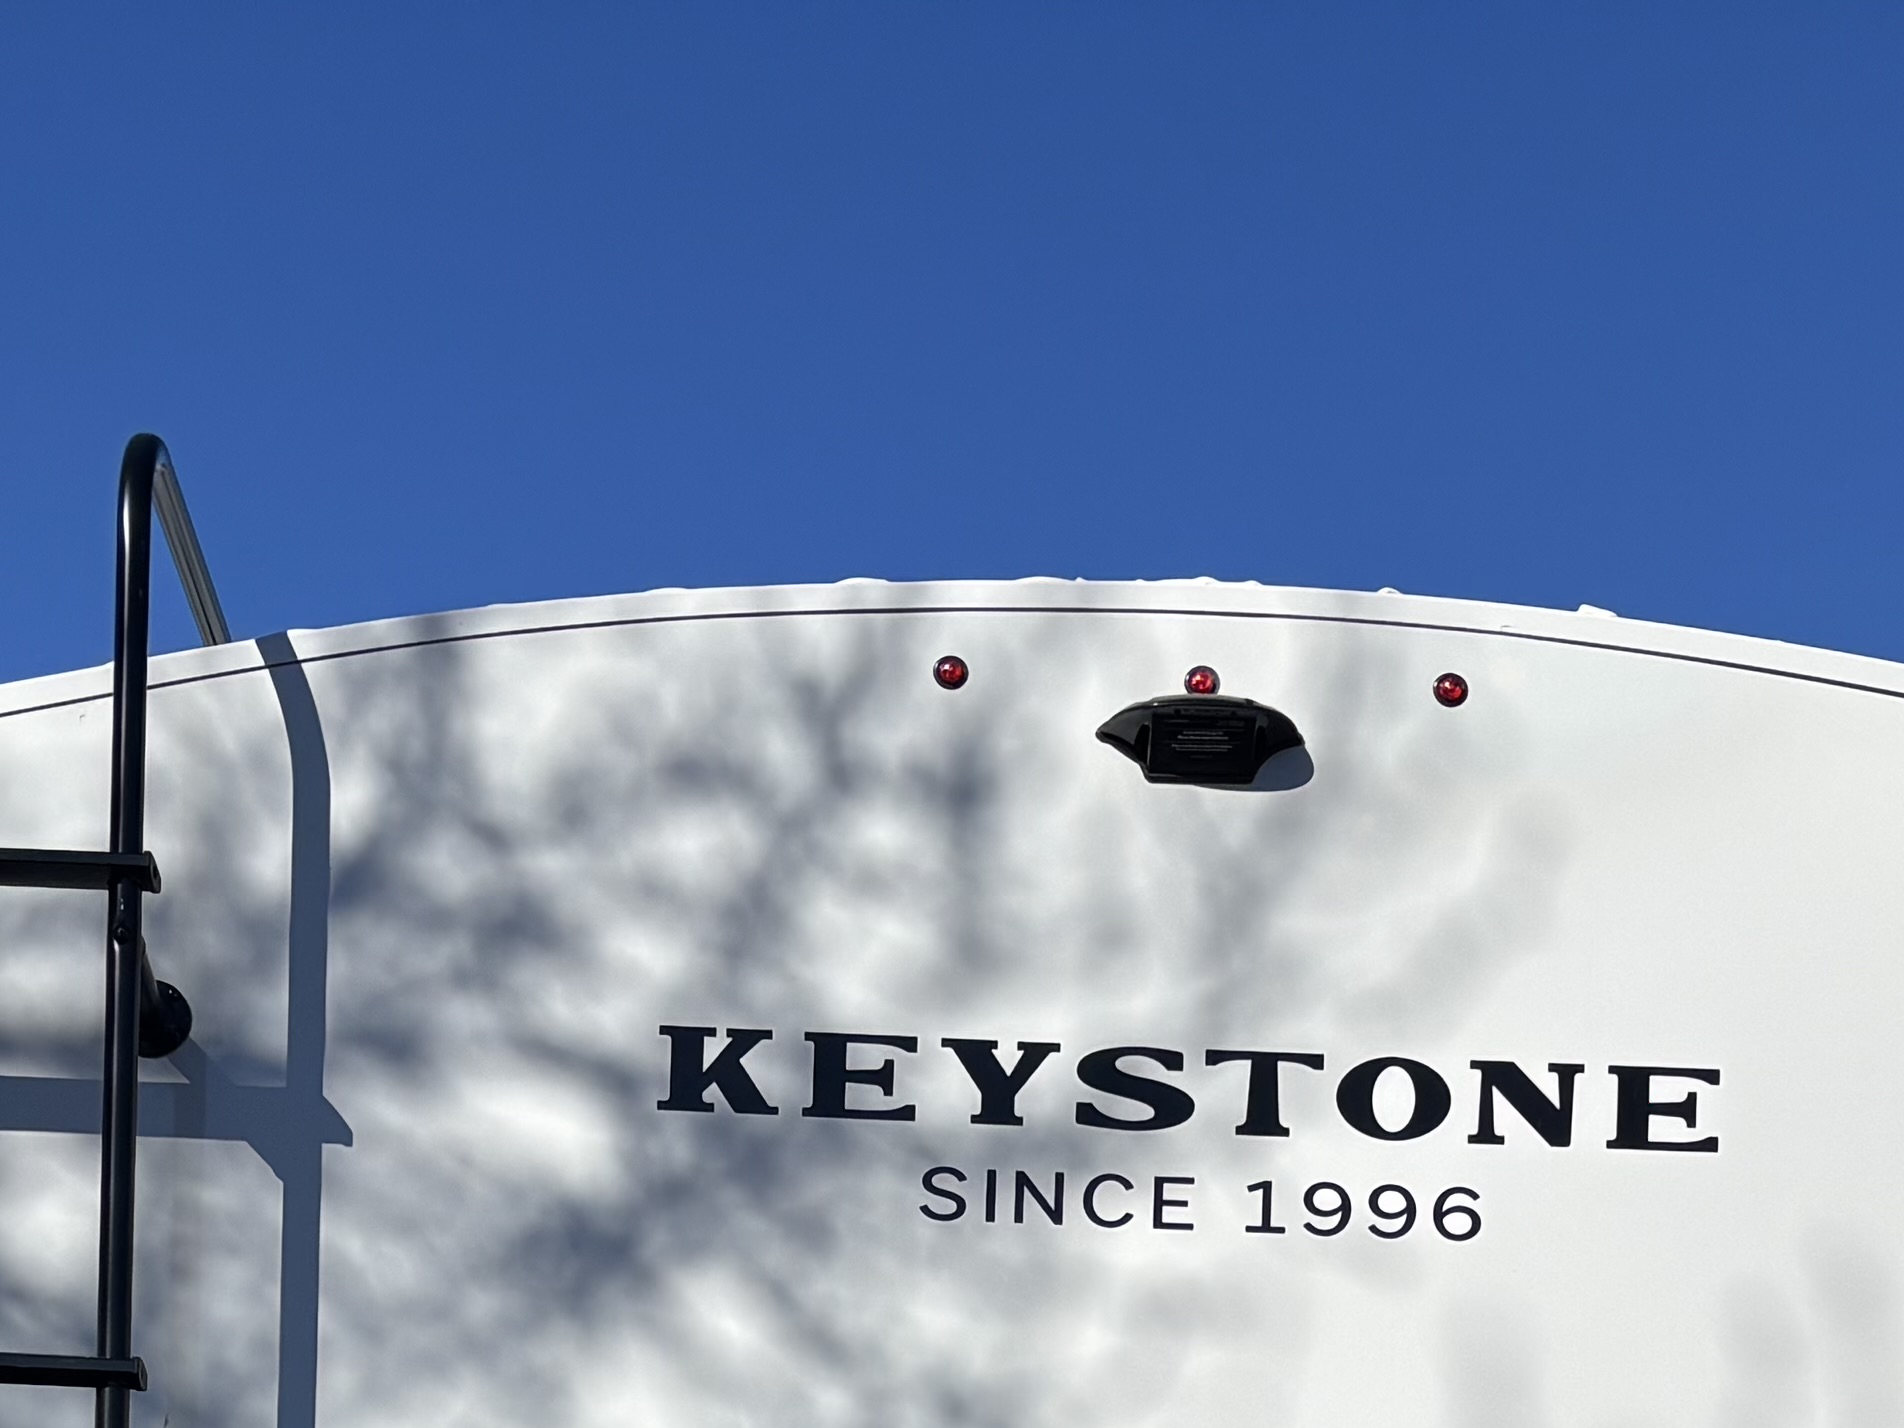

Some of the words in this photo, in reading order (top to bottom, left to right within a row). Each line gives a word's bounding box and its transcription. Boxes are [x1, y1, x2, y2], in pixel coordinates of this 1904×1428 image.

[657, 1025, 1720, 1153] KEYSTONE
[919, 1166, 1195, 1231] SINCE
[1245, 1180, 1483, 1242] 1996
